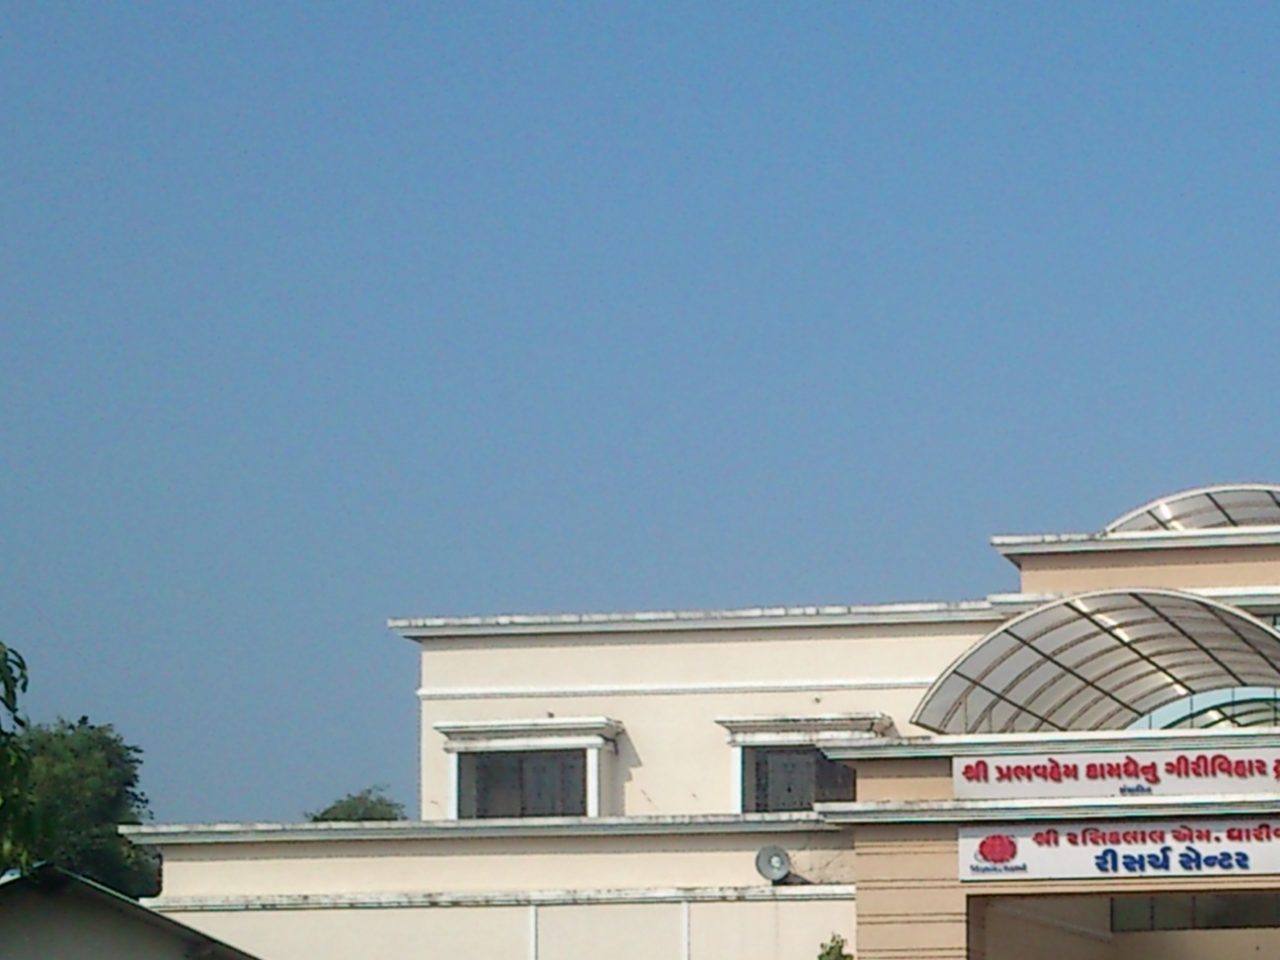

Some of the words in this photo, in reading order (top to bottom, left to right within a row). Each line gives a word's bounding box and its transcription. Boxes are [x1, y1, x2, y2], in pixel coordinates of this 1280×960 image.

[962, 758, 988, 784] શ્રી
[1086, 755, 1161, 785] કામધેનુ
[1165, 754, 1267, 779] ગીરીવિહાર
[1032, 829, 1060, 847] શ્રી
[1094, 847, 1172, 873] રીસર્ચ
[1179, 846, 1250, 872] સેન્ટર
